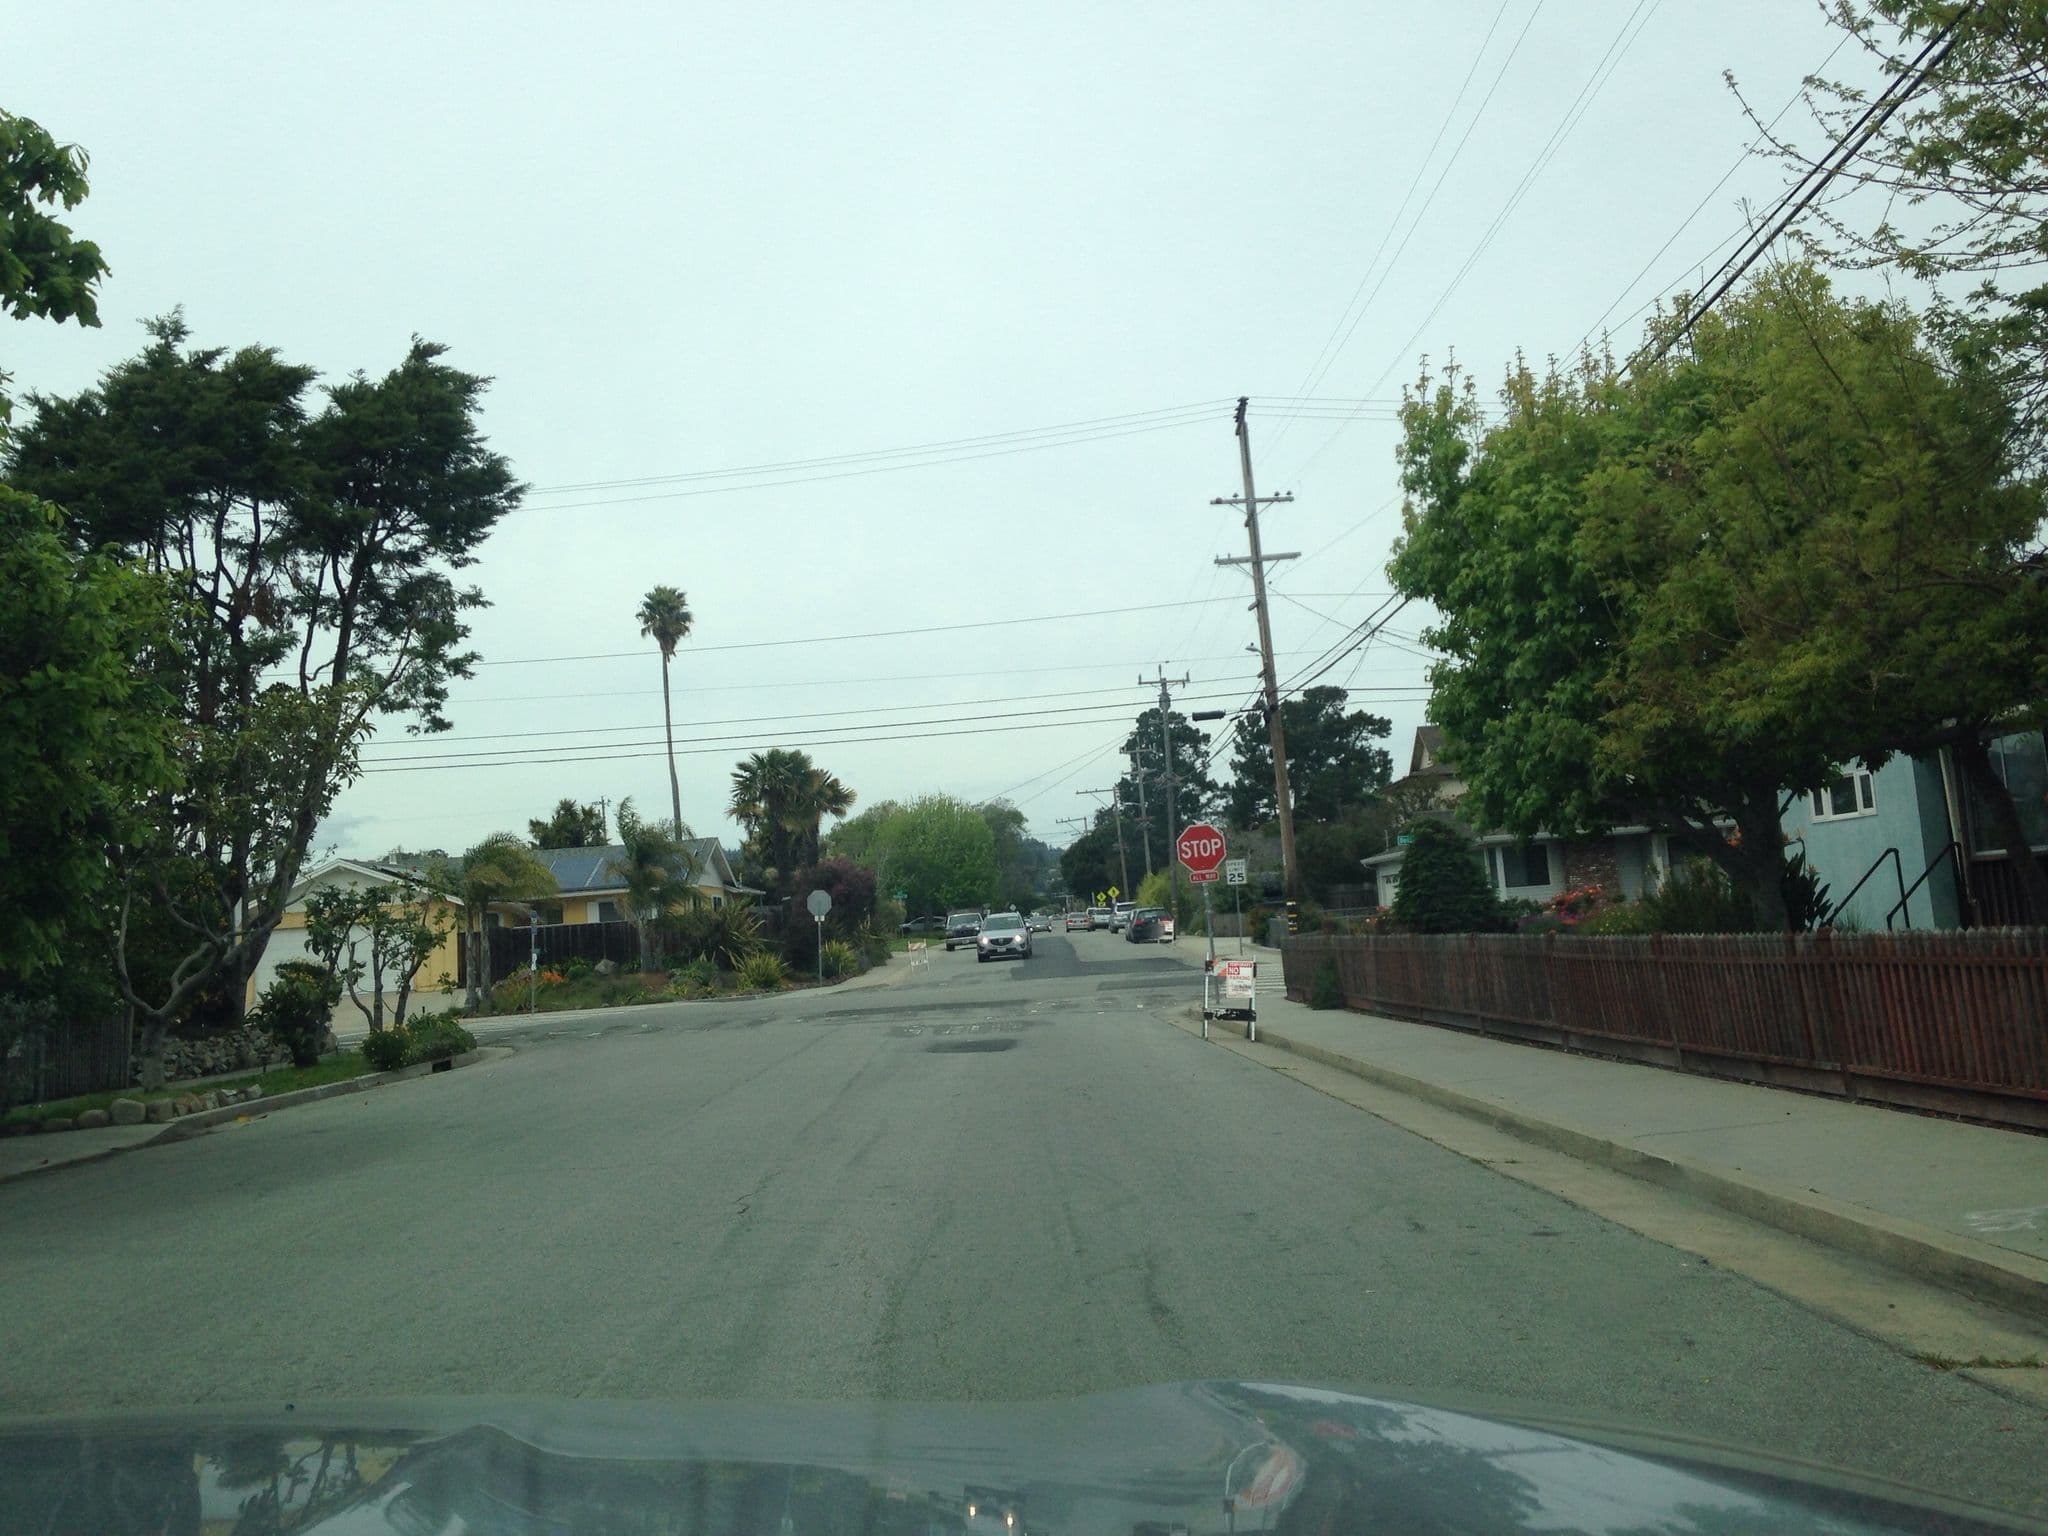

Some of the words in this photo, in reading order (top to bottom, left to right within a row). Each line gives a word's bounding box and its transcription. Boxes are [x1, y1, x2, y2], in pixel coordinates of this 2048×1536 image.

[1181, 839, 1221, 859] STOP
[1192, 873, 1202, 881] ALL
[1229, 873, 1245, 883] 25
